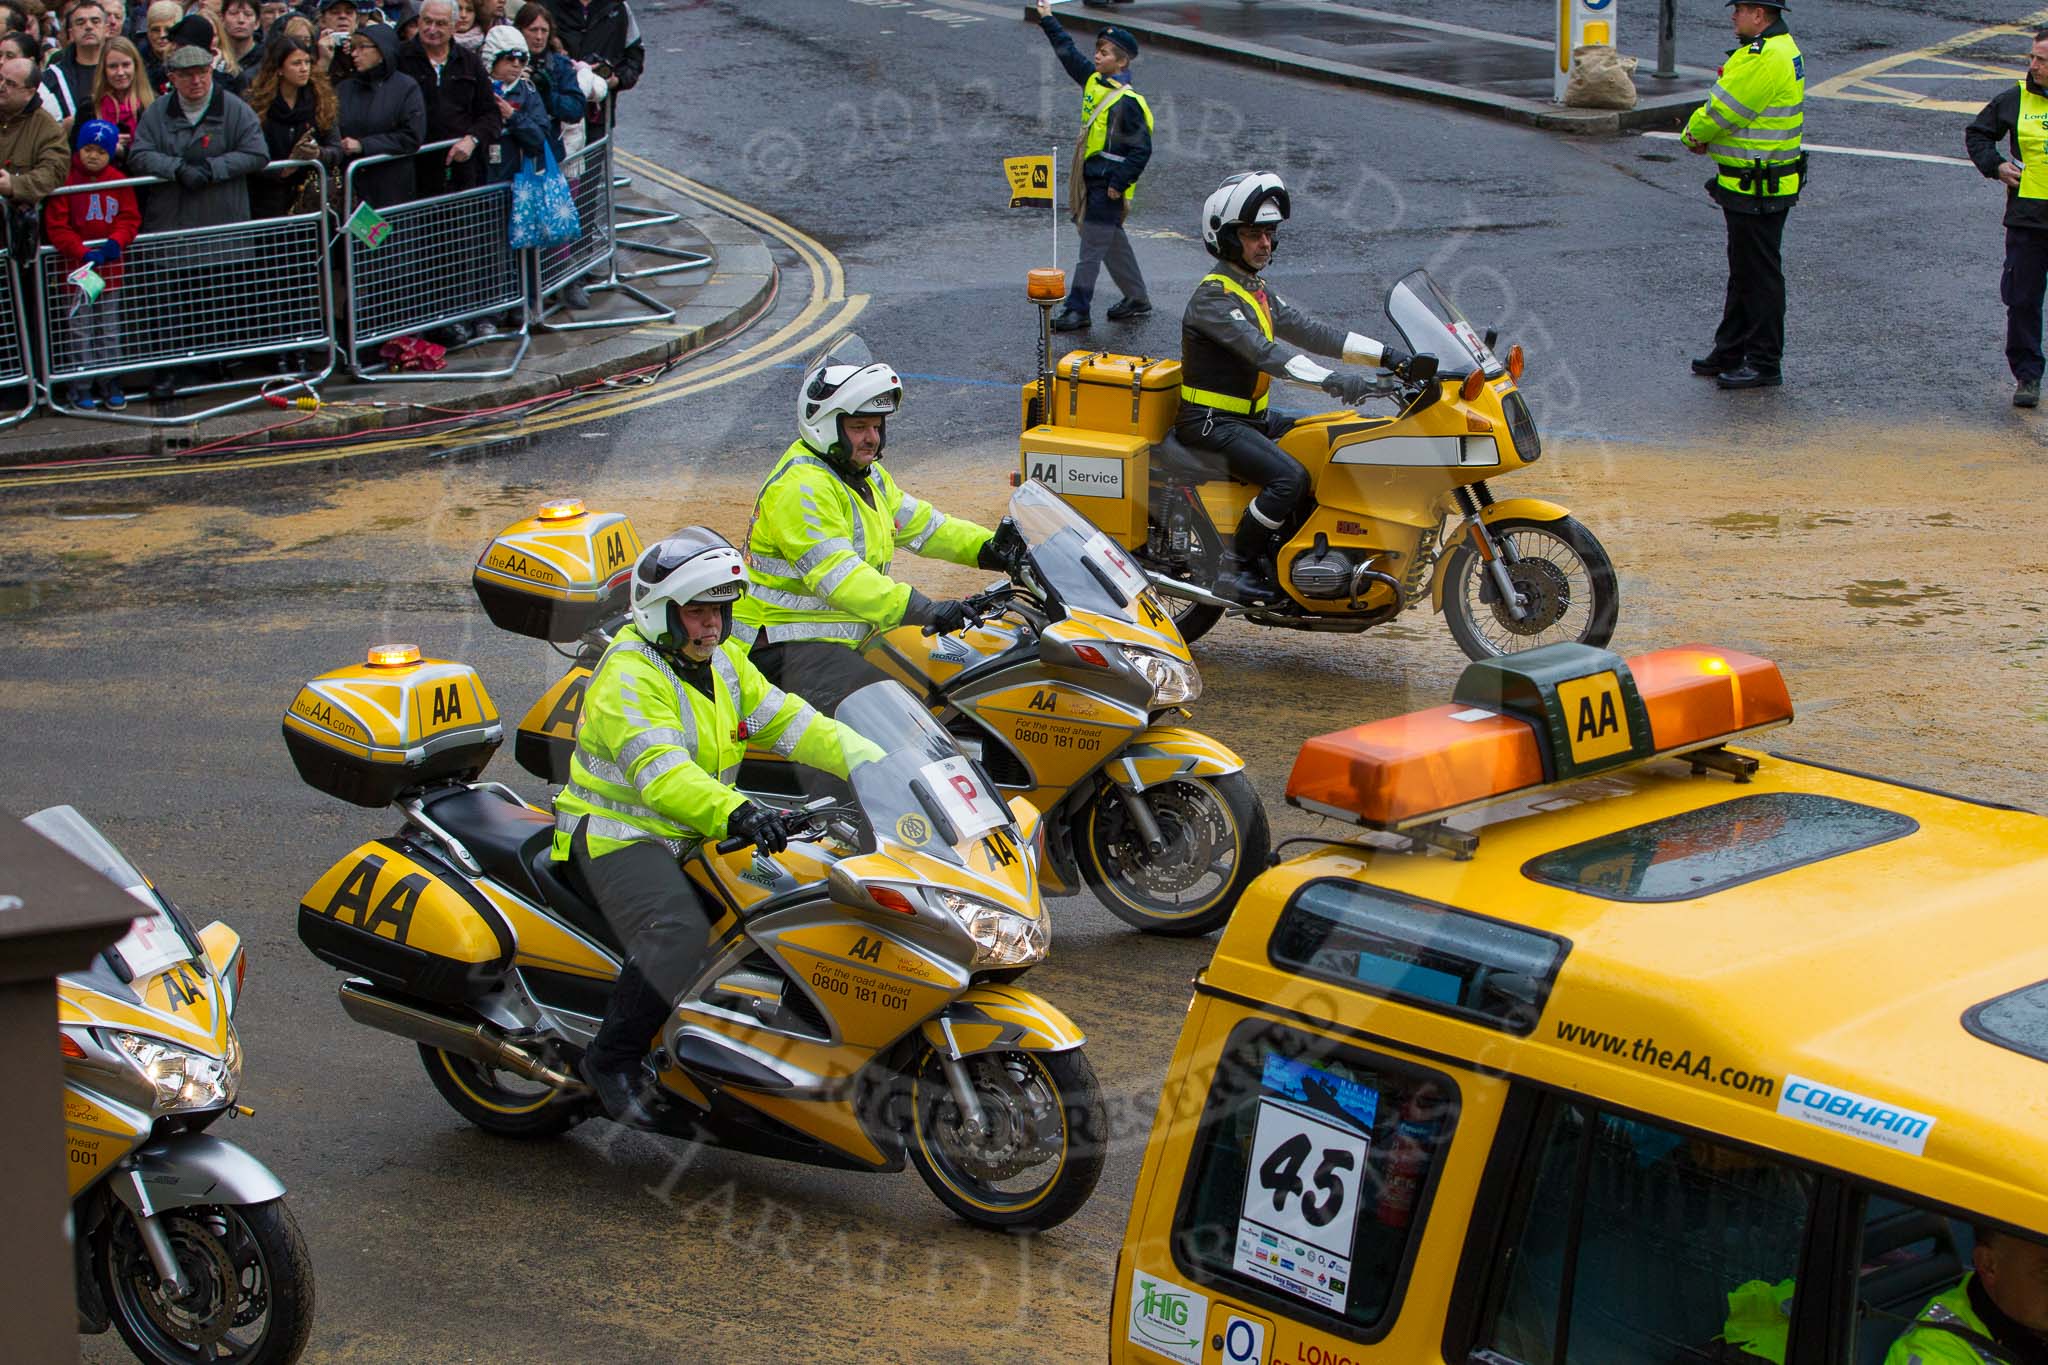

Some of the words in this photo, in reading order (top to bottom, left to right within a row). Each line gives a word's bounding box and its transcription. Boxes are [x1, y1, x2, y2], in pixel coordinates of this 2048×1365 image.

[1031, 463, 1057, 483] AA
[1068, 469, 1118, 484] Service
[489, 554, 554, 582] theAA.com
[606, 531, 626, 570] AA
[931, 652, 966, 663] HONDA
[296, 700, 356, 736] theAA.com
[432, 683, 462, 726] AA
[1028, 690, 1057, 712] AA
[1577, 690, 1619, 742] AA
[1015, 718, 1031, 728] For
[1032, 721, 1047, 731] the
[1049, 724, 1071, 734] road
[1072, 727, 1102, 738] ahead
[1015, 728, 1048, 745] 0800
[1054, 735, 1073, 748] 181
[1078, 738, 1100, 751] 001
[948, 774, 978, 814] P
[981, 832, 1018, 872] AA
[323, 853, 432, 945] AA
[848, 936, 883, 963] AA
[162, 967, 206, 1012] AA
[812, 972, 848, 996] 0800
[855, 986, 877, 1004] 181
[882, 994, 908, 1011] 001
[815, 962, 832, 973] For
[833, 967, 850, 980] the
[852, 975, 876, 987] road
[878, 981, 911, 996] ahead
[1557, 1021, 1774, 1097] www.theAA.com
[1784, 1082, 1928, 1139] COBHAM
[71, 1149, 98, 1166] 001
[1260, 1133, 1354, 1227] 45
[1140, 1280, 1188, 1325] THIG
